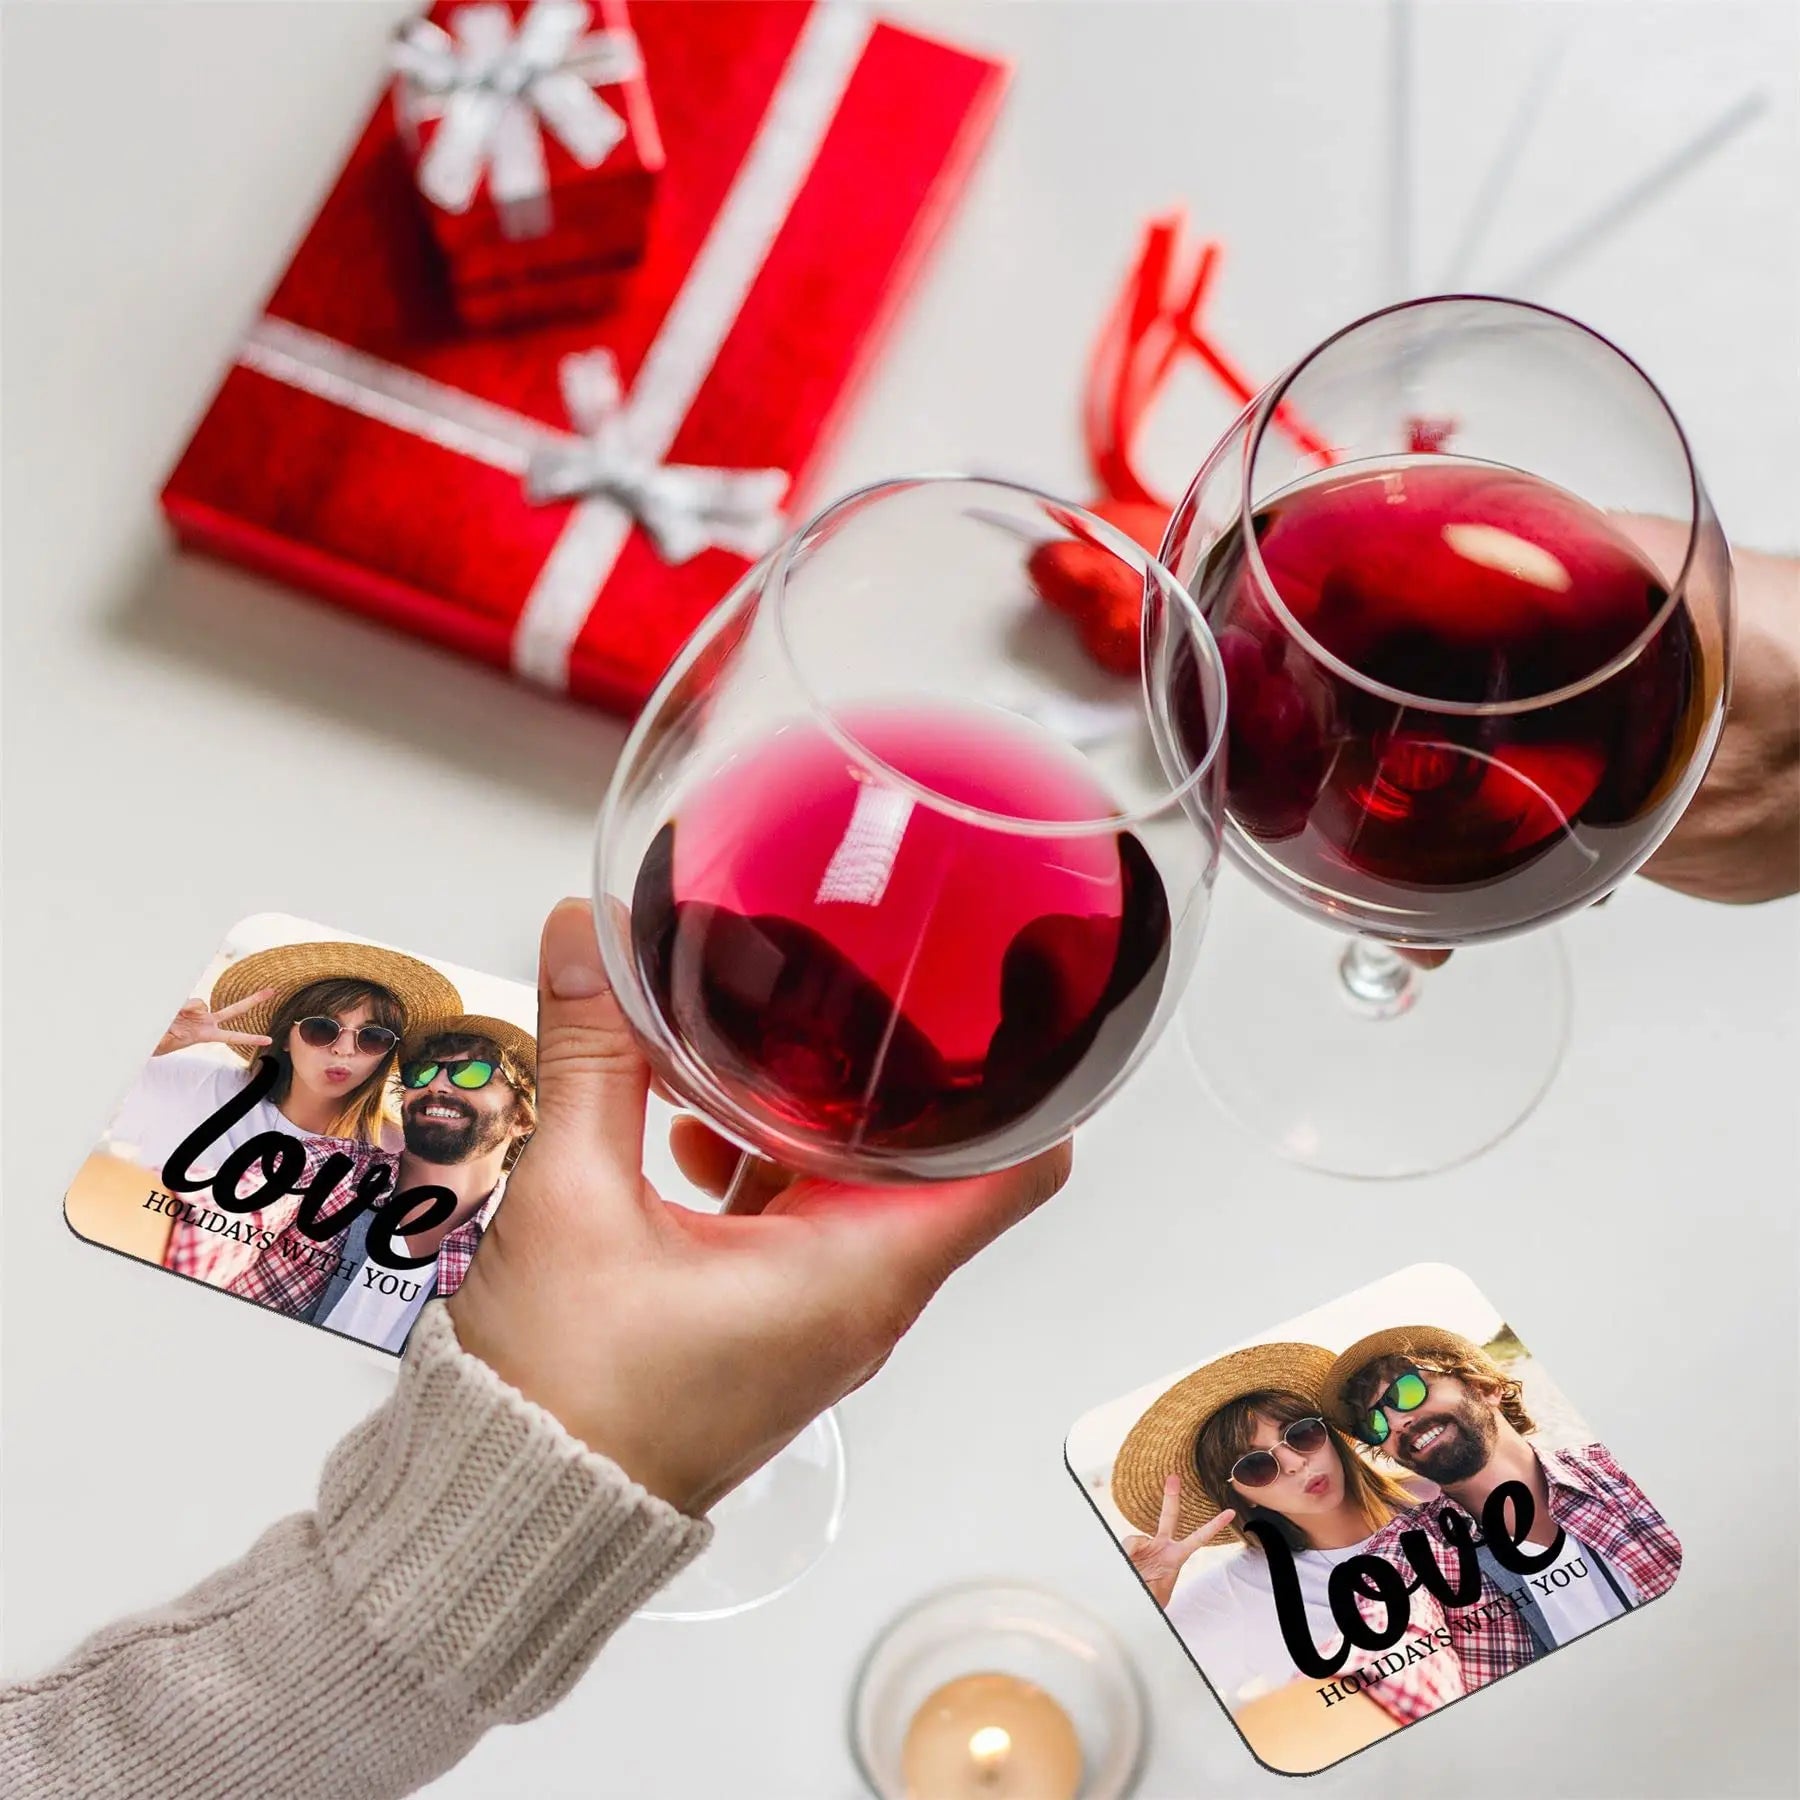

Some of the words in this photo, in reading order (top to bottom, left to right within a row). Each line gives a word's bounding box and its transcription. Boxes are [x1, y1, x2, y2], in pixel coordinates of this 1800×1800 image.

[142, 1190, 275, 1251] HOLIDAYS
[281, 1238, 359, 1281] WITH
[363, 1266, 421, 1303] YOU
[162, 1057, 458, 1269] love
[1243, 1481, 1566, 1679] love
[1316, 1627, 1454, 1707] HOLIDAYS
[1453, 1588, 1532, 1637] WITH
[1530, 1557, 1589, 1597] YOU
